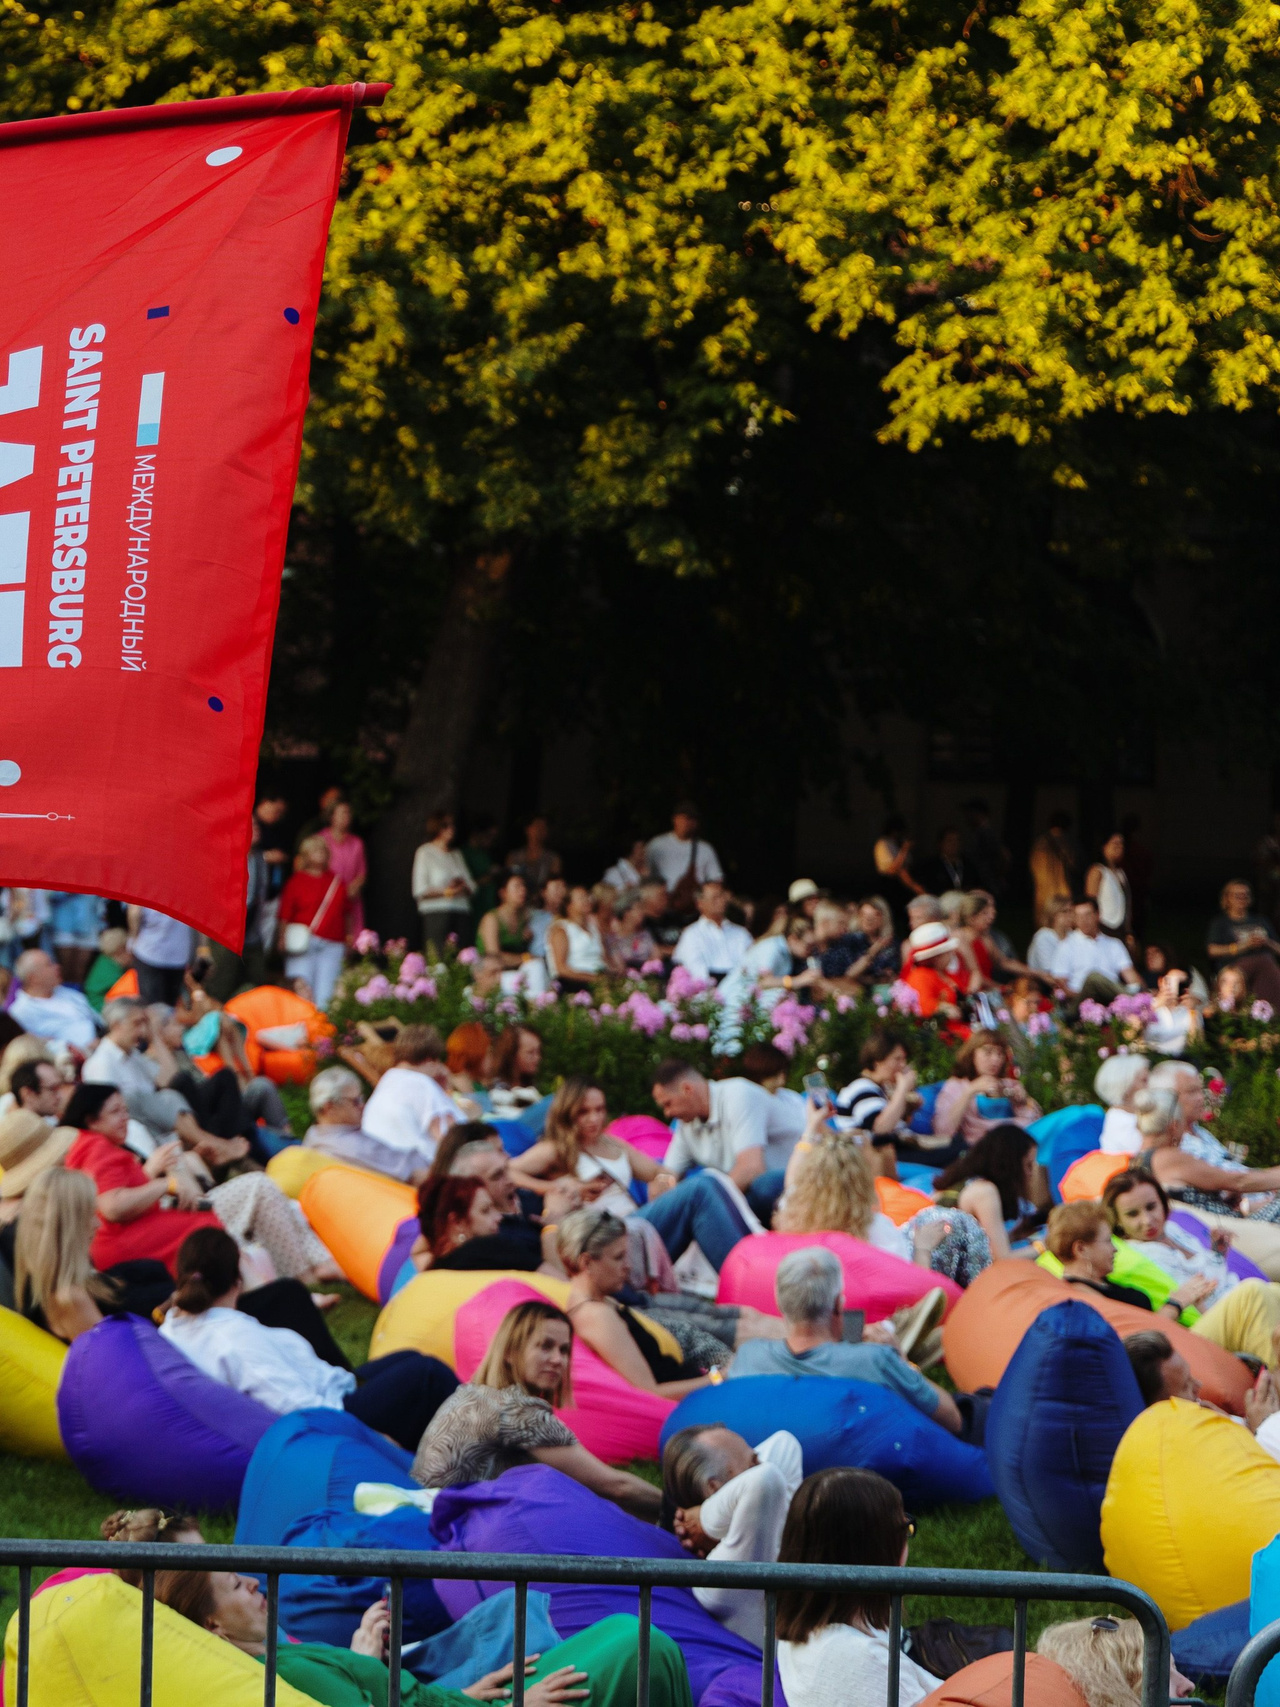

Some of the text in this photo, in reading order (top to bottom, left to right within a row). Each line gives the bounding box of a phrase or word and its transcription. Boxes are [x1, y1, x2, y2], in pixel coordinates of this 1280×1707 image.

[47, 323, 106, 668] SAINT PETERSBURG
[120, 454, 156, 671] МЕЖДУНАРОДНЫЙ
